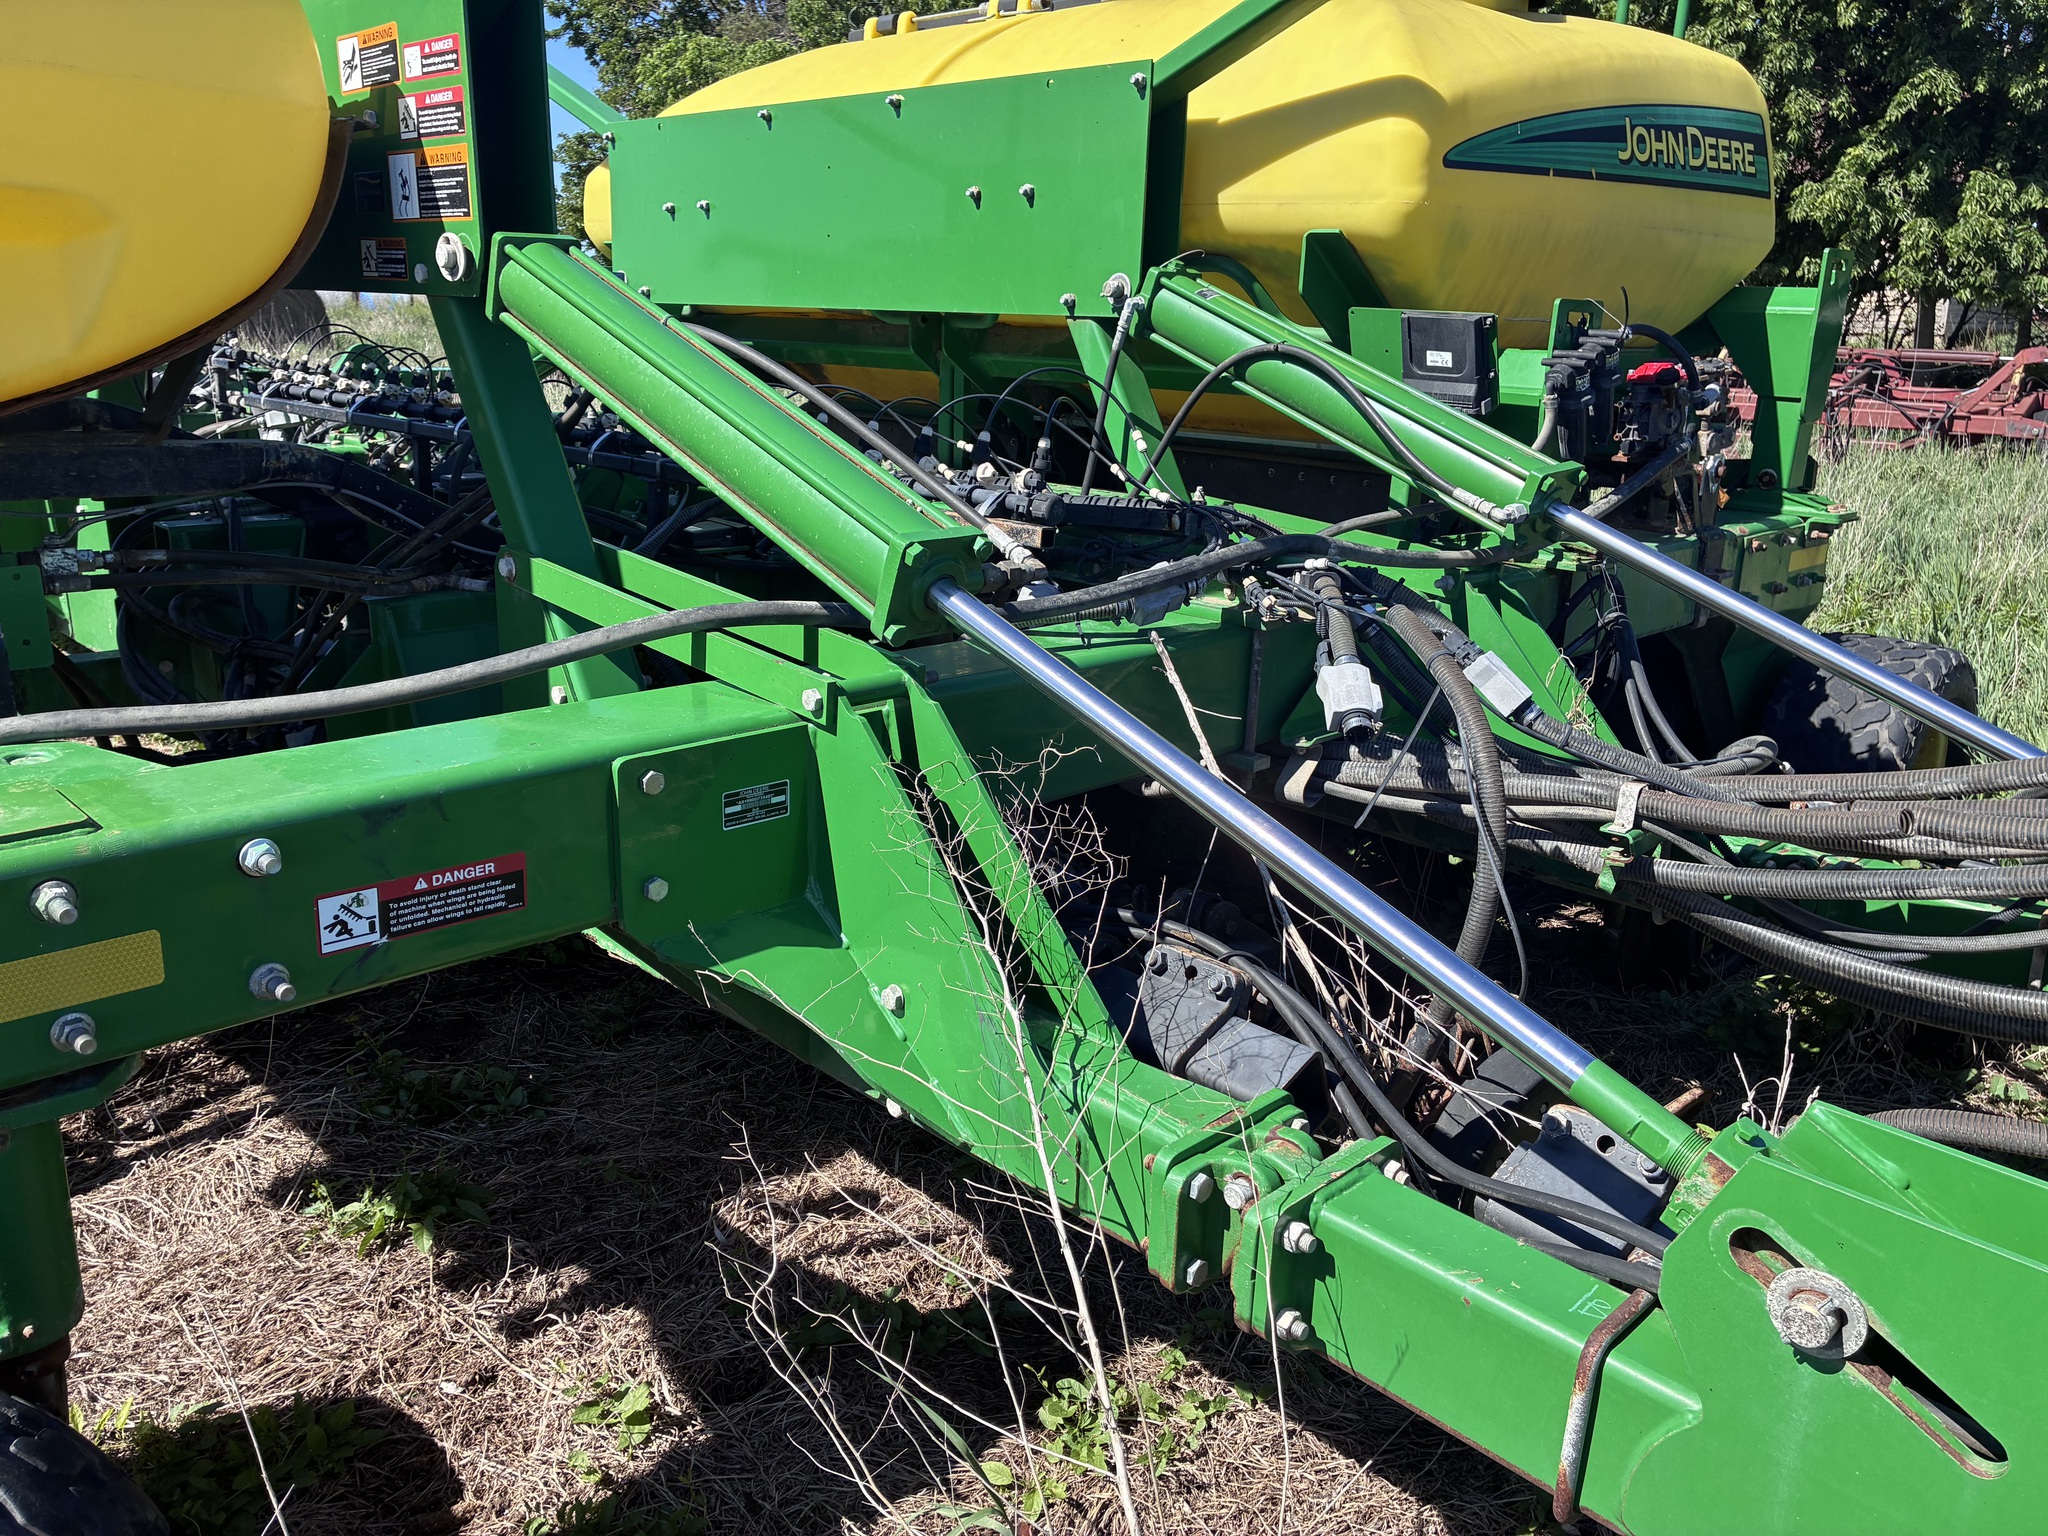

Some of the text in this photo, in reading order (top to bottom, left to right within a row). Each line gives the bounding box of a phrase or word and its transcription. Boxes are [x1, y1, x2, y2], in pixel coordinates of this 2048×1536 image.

[366, 27, 393, 42] WARNING
[431, 38, 453, 51] DANGER
[430, 91, 453, 103] DANGER
[429, 151, 462, 164] WARNING
[432, 863, 494, 886] DANGER
[399, 905, 426, 915] machine
[428, 900, 445, 909] when
[447, 895, 465, 906] wings
[478, 888, 495, 897] being
[497, 883, 515, 892] folded
[400, 897, 418, 907] avoid
[420, 893, 438, 904] injury
[449, 887, 466, 895] death
[468, 883, 485, 891] stand
[486, 879, 501, 887] clear
[391, 923, 412, 932] failure
[427, 916, 444, 924] allow
[446, 910, 464, 920] wings
[485, 901, 507, 911] rapidly.
[399, 911, 430, 923] unfolded.
[432, 902, 467, 915] Mechanical
[477, 894, 505, 905] hydraulic
